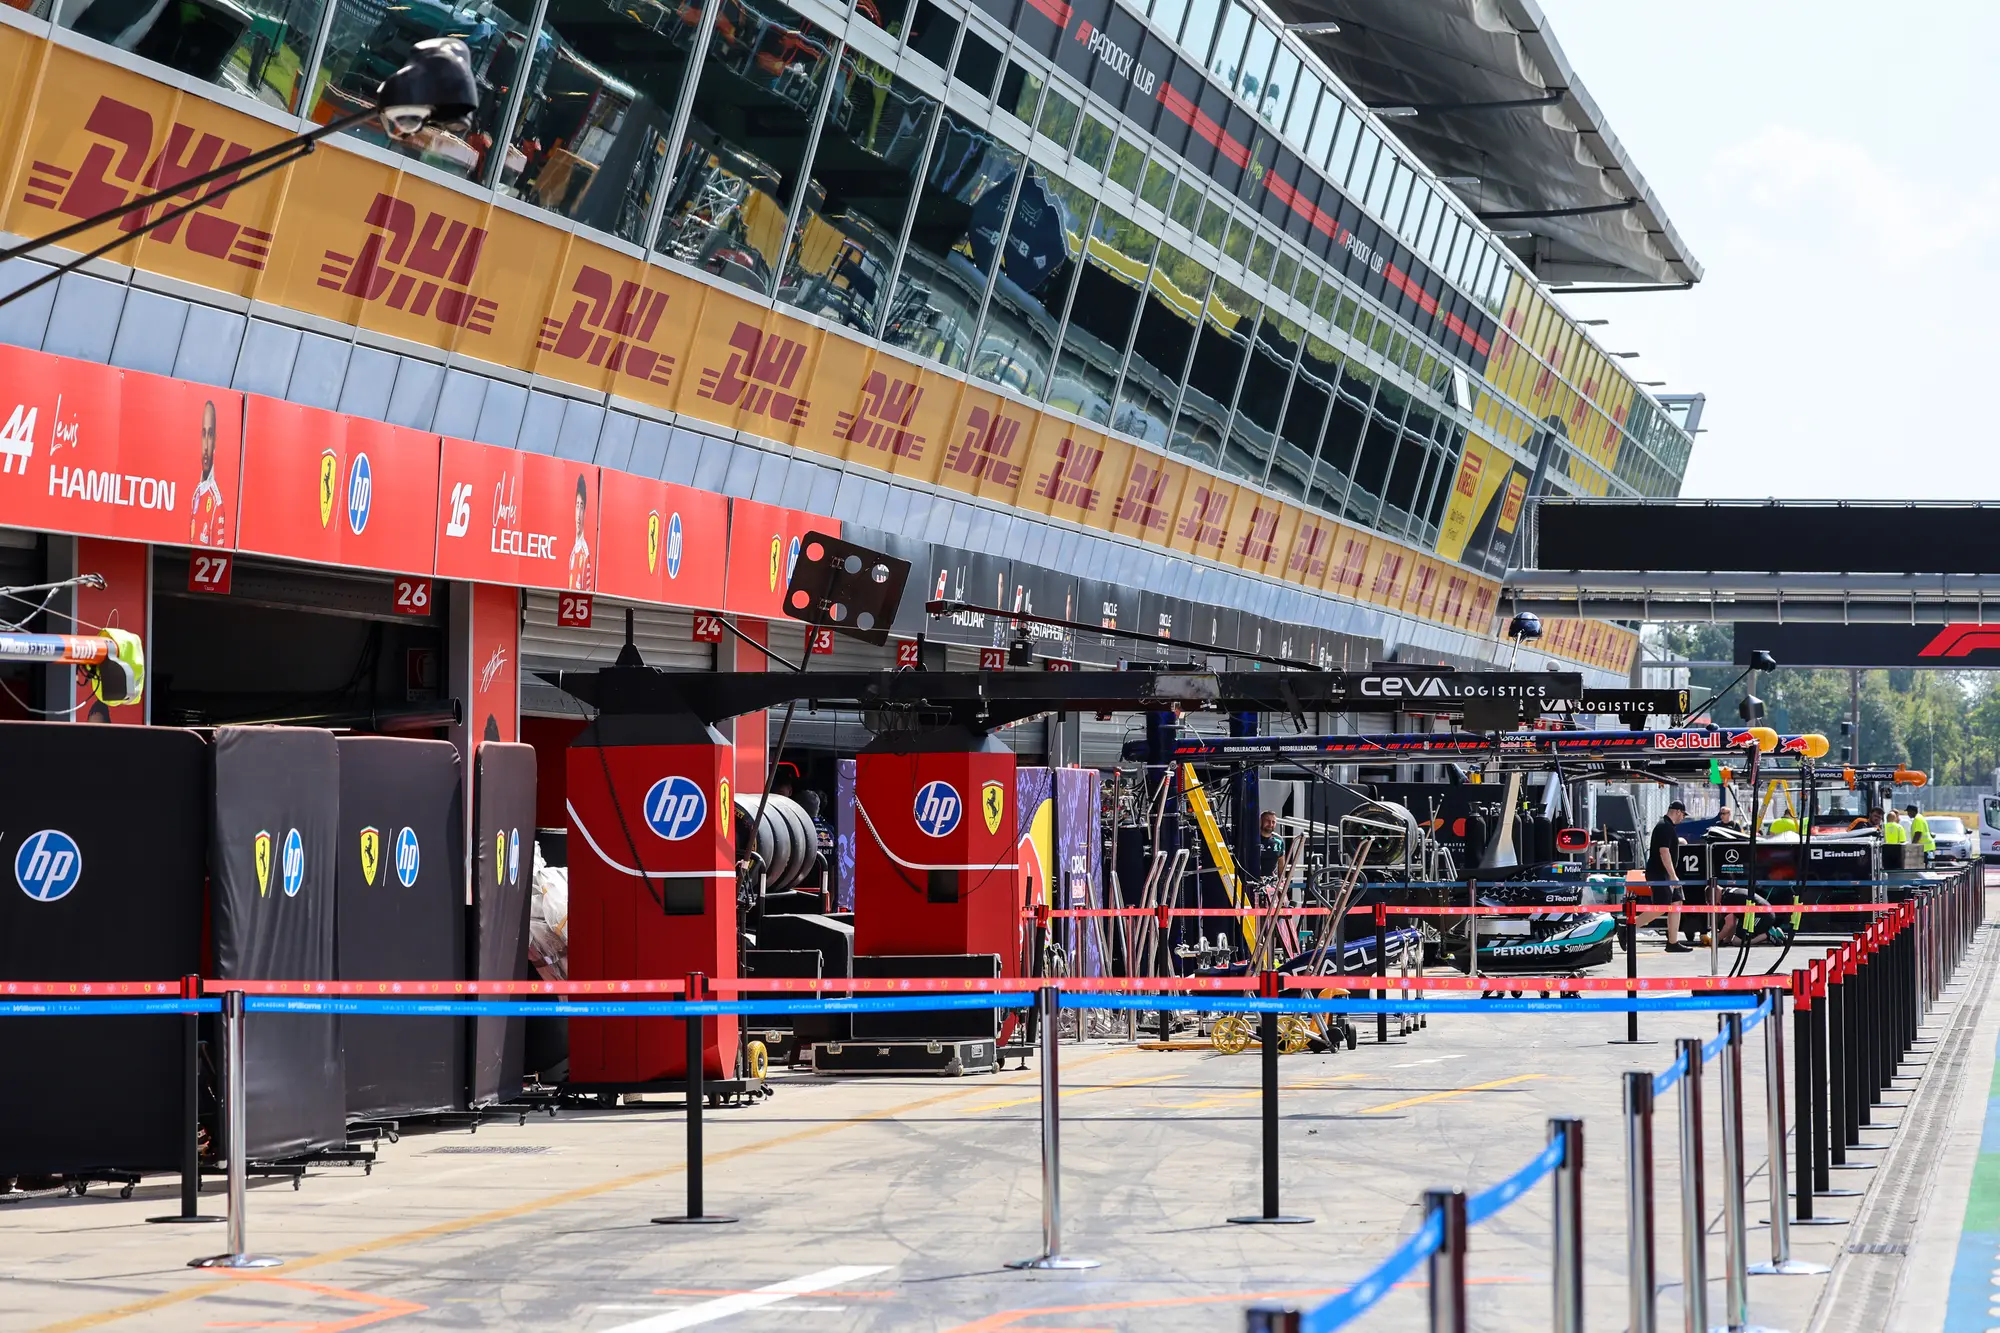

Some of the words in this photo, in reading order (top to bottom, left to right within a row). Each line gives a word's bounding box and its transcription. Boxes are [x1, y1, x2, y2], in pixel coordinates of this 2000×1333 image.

[1088, 27, 1134, 80] PADDOCK
[1134, 63, 1156, 95] CLUB
[56, 96, 254, 261] DHL
[343, 192, 488, 329] DHL
[1345, 233, 1371, 266] PADDOCK
[1371, 252, 1384, 273] CLUB
[552, 265, 670, 380] DHL
[712, 321, 808, 425] DHL
[50, 394, 79, 456] Lewis
[845, 371, 925, 457] DHL
[0, 405, 38, 475] 44
[954, 406, 1021, 485] DHL
[48, 464, 176, 512] HAMILTON
[350, 454, 371, 534] hp
[1043, 438, 1104, 510] DHL
[445, 482, 473, 538] 16
[1116, 464, 1171, 530] DHL
[1185, 486, 1229, 547] DHL
[490, 528, 557, 561] LECLERC
[667, 513, 682, 578] hp
[1239, 507, 1281, 563] DHL
[194, 556, 228, 584] 27
[397, 582, 427, 608] 26
[562, 598, 589, 621] 25
[1102, 601, 1118, 617] ORACLE
[697, 616, 721, 636] 24
[952, 608, 985, 629] HADJAR
[38, 643, 55, 656] TEAM
[70, 637, 97, 660] Gulf
[900, 644, 918, 662] 22
[983, 652, 1002, 669] 21
[1360, 677, 1451, 697] CEVA
[1454, 685, 1546, 697] LOGISTICS
[1578, 701, 1655, 712] LOGISTICS
[1223, 745, 1271, 753] REDBULLRACING.COM
[1654, 733, 1687, 750] Red
[1687, 732, 1720, 749] Bull
[653, 777, 699, 840] hp
[919, 782, 957, 837] hp
[23, 831, 75, 901] hp
[283, 829, 303, 897] hp
[397, 827, 418, 887] hp
[1682, 855, 1699, 872] 12
[1825, 850, 1860, 858] Einhell
[1493, 944, 1560, 957] PETRONAS
[12, 1005, 46, 1013] Williams
[287, 1001, 322, 1010] Williams
[555, 1005, 589, 1013] Williams
[1249, 1001, 1284, 1009] Williams
